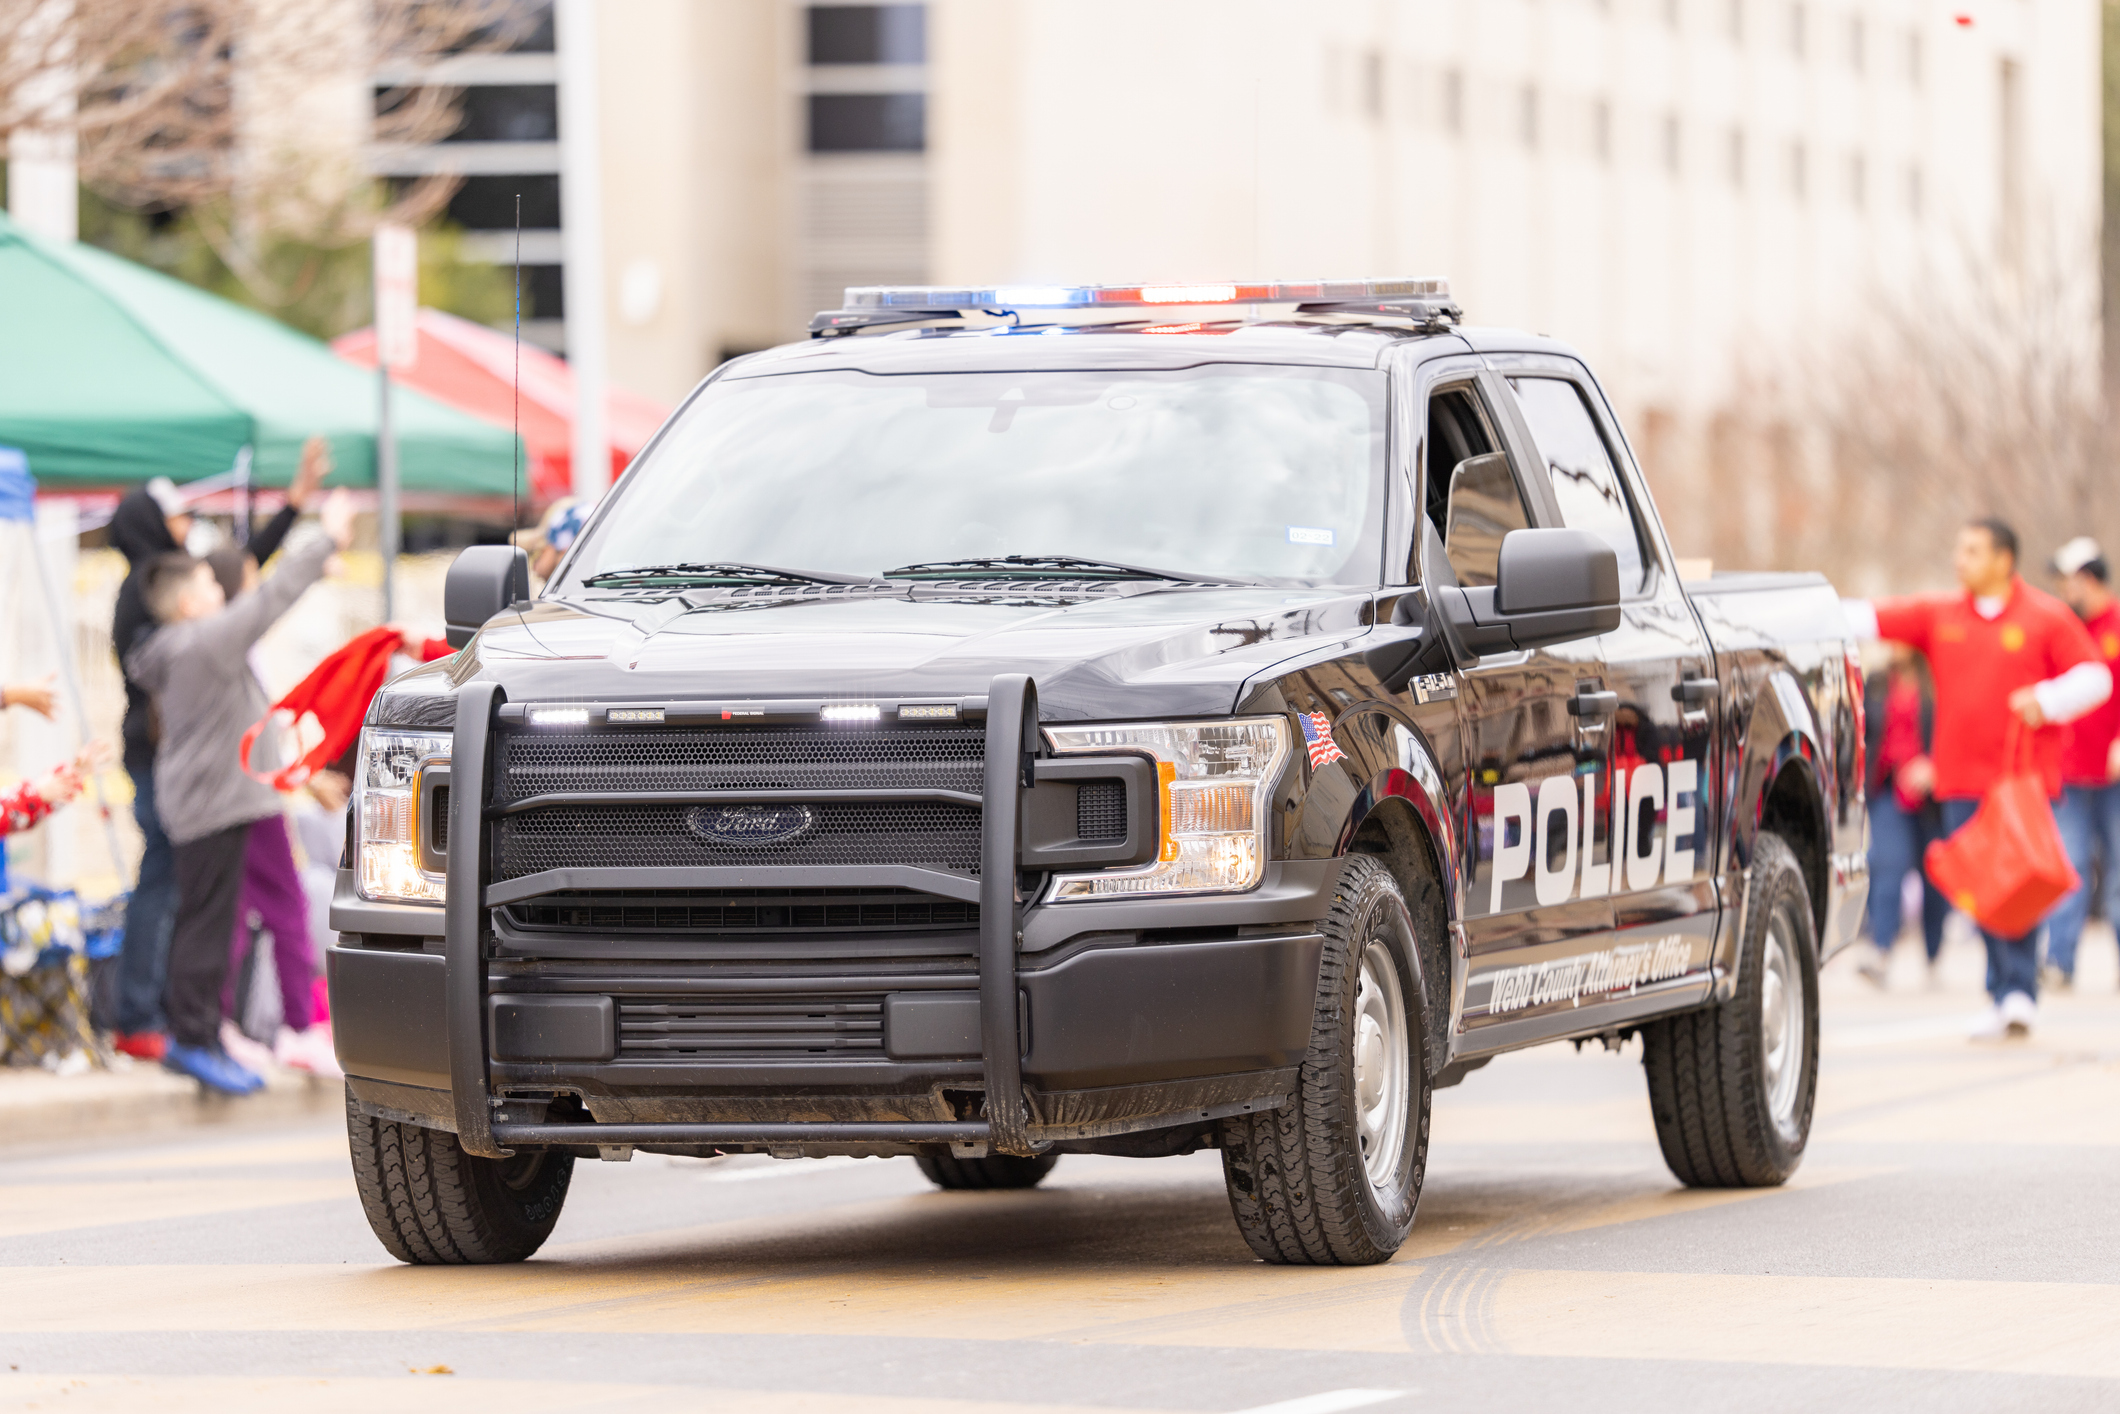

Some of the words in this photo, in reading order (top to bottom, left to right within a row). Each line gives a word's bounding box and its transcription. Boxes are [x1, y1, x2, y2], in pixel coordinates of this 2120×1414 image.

[1490, 759, 1697, 914] POLICE
[1489, 965, 1533, 1014] Webb
[1533, 957, 1586, 1008] County
[1583, 942, 1653, 996] Attorney's
[1651, 934, 1692, 982] Office
